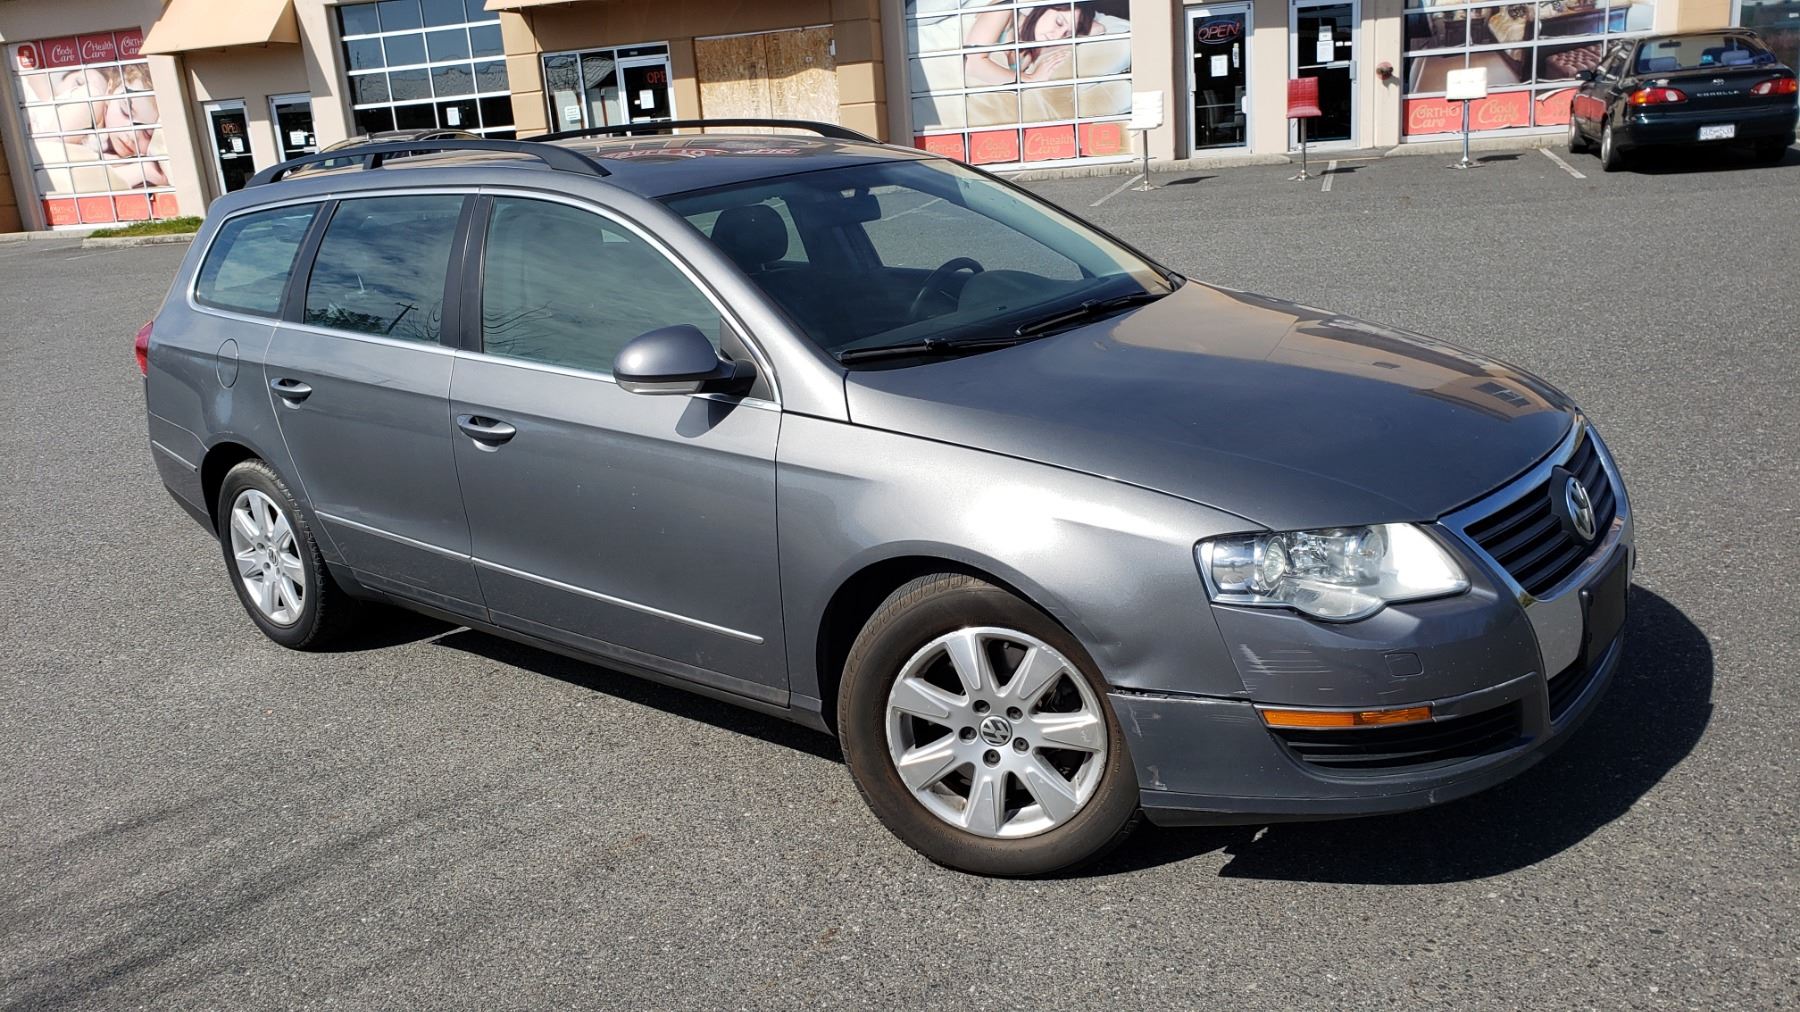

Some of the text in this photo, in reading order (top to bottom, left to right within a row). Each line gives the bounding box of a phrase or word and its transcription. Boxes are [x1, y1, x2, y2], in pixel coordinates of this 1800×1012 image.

[1197, 22, 1240, 40] OPEN
[91, 41, 114, 52] Health
[1416, 104, 1460, 118] ORTHO
[1477, 100, 1518, 124] Care
[1489, 100, 1519, 116] Body
[1410, 105, 1446, 129] Care
[1040, 134, 1073, 146] Health
